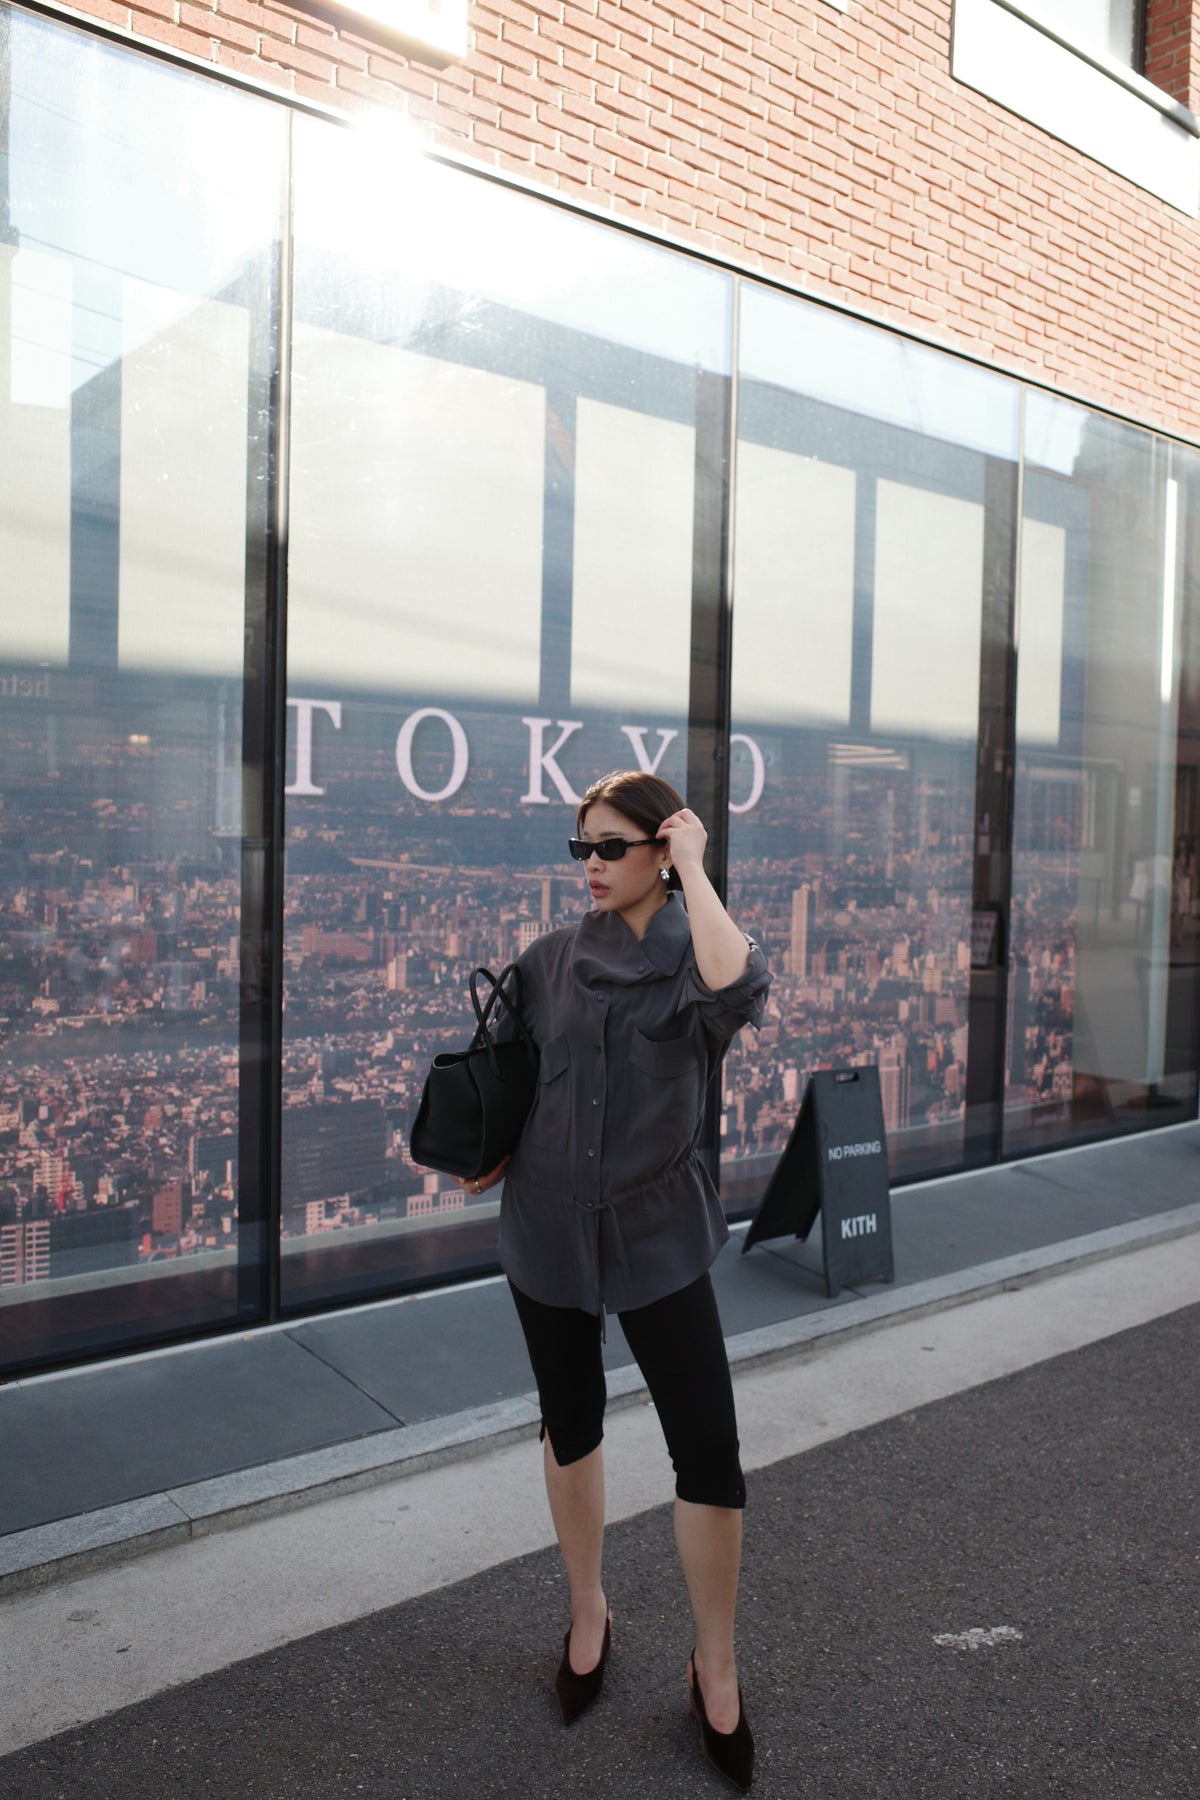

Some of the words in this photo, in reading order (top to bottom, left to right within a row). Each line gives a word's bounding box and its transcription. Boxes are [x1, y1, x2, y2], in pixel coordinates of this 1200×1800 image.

[284, 697, 765, 813] TOKYO
[828, 1146, 842, 1161] NO
[843, 1141, 881, 1158] PARKING
[841, 1213, 877, 1239] KITH
